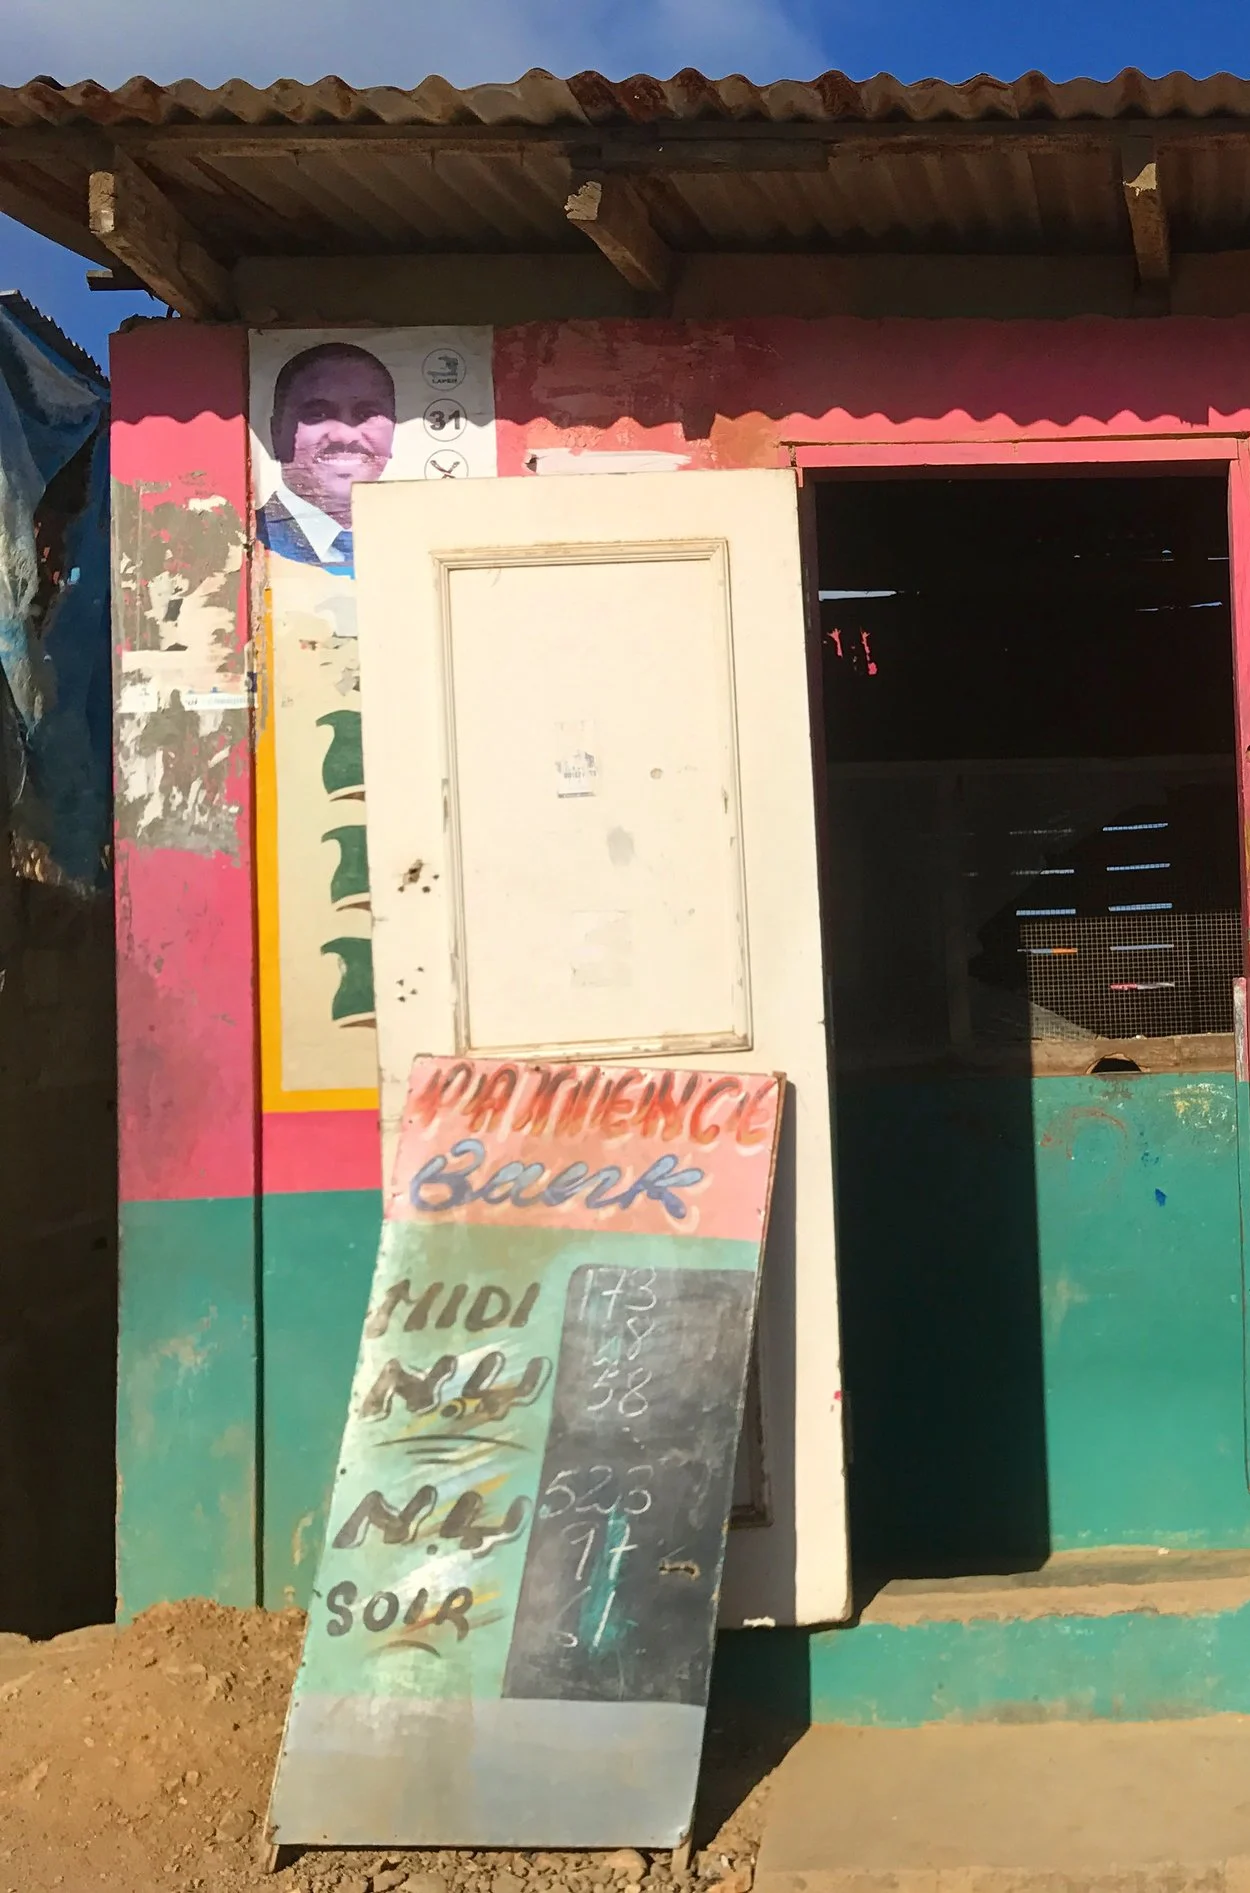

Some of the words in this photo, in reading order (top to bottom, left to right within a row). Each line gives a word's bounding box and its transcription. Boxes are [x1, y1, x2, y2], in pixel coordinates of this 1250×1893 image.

[429, 409, 461, 431] 31
[413, 1061, 780, 1149] PATIENCE
[410, 1138, 705, 1219] Bank
[365, 1279, 541, 1339] MIDI
[579, 1267, 657, 1320] 173
[539, 1465, 654, 1518] 523
[326, 1581, 474, 1643] SOIR
